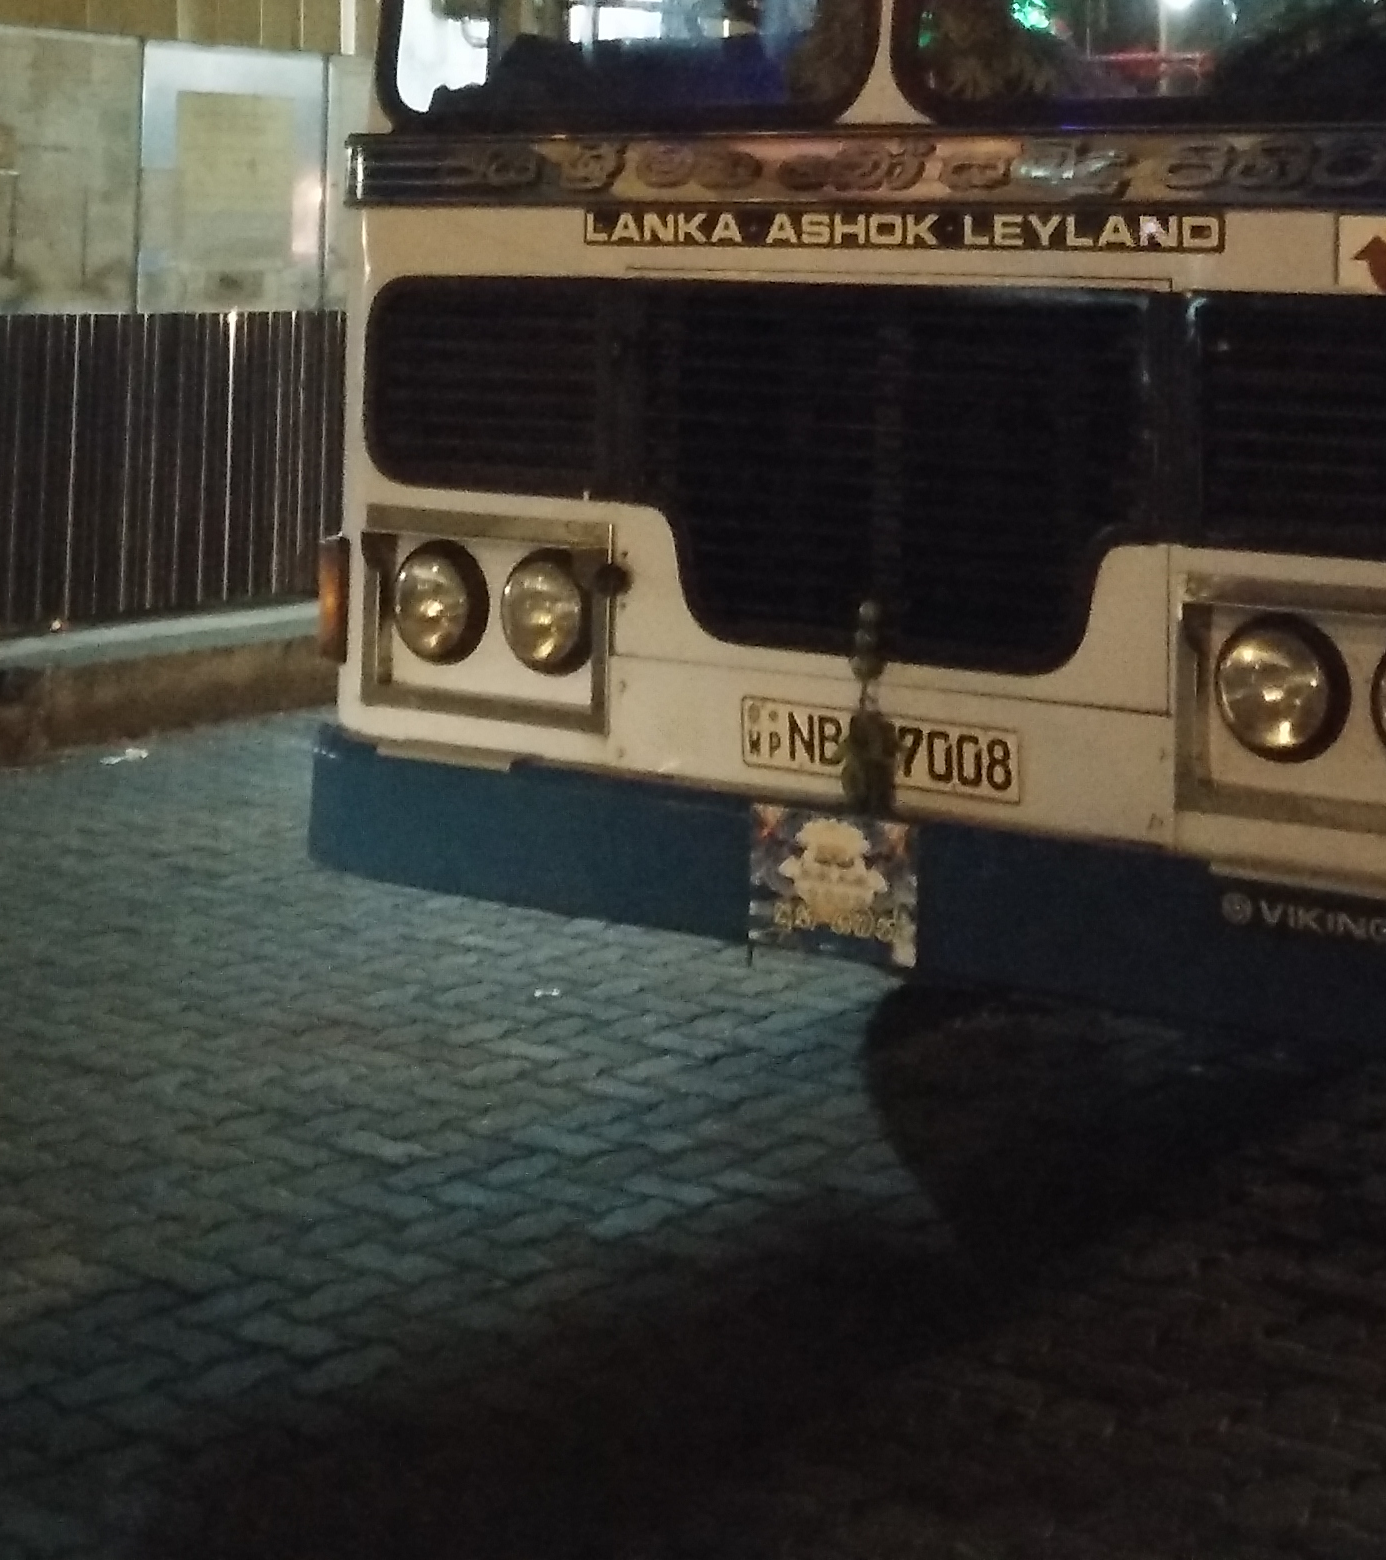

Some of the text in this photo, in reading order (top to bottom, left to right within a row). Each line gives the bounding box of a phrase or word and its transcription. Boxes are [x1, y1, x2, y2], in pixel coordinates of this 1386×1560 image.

[585, 213, 1219, 249] LANKA ASHOK LEYLAND
[748, 729, 781, 759] WP
